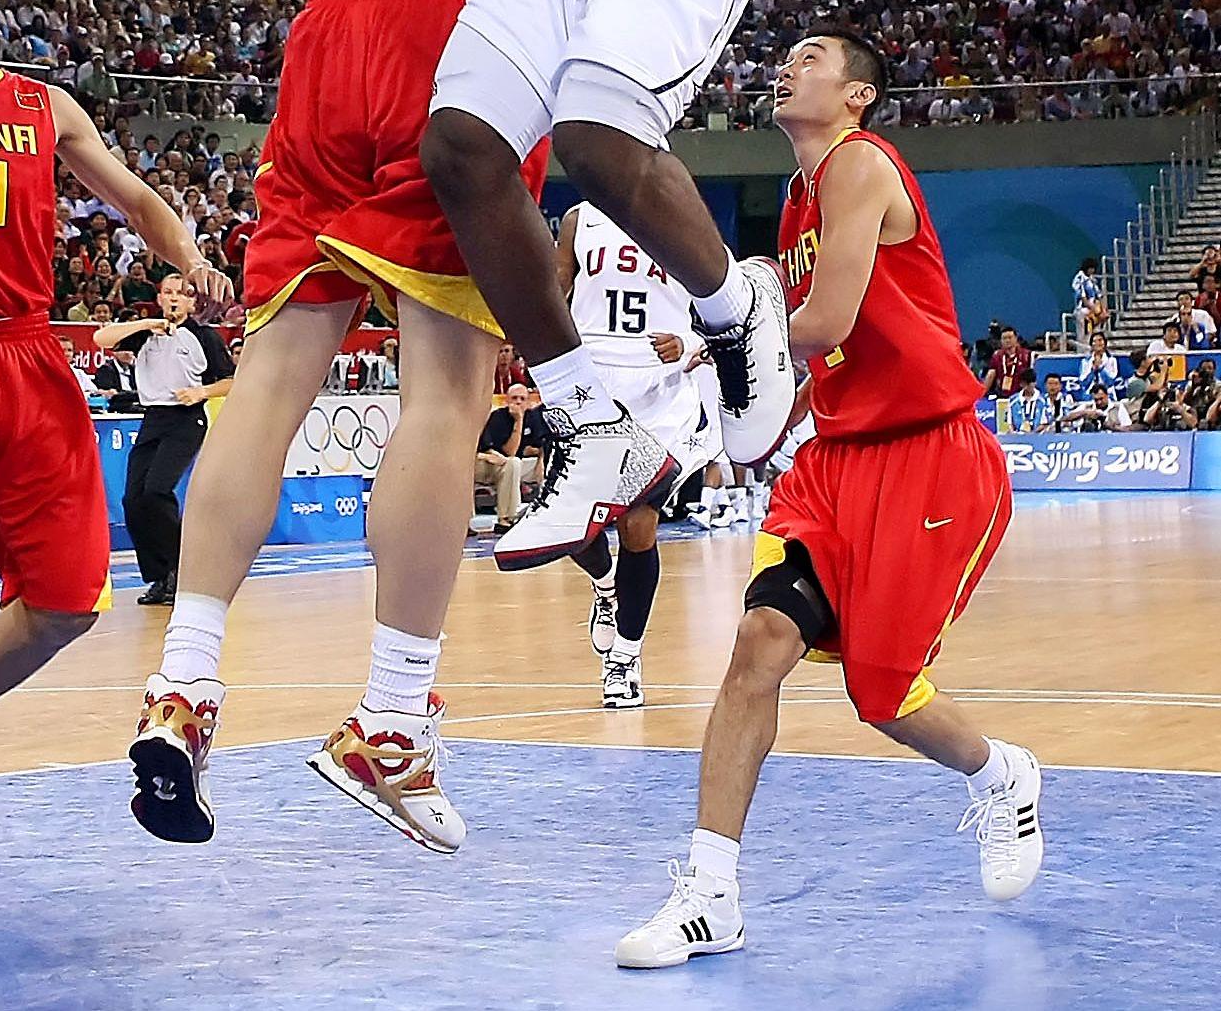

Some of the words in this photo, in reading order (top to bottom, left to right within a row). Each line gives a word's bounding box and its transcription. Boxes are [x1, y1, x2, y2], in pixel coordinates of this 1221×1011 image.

[587, 246, 667, 284] USA
[605, 289, 647, 333] 15
[1000, 441, 1100, 482] Beijing
[1103, 445, 1180, 475] 2008
